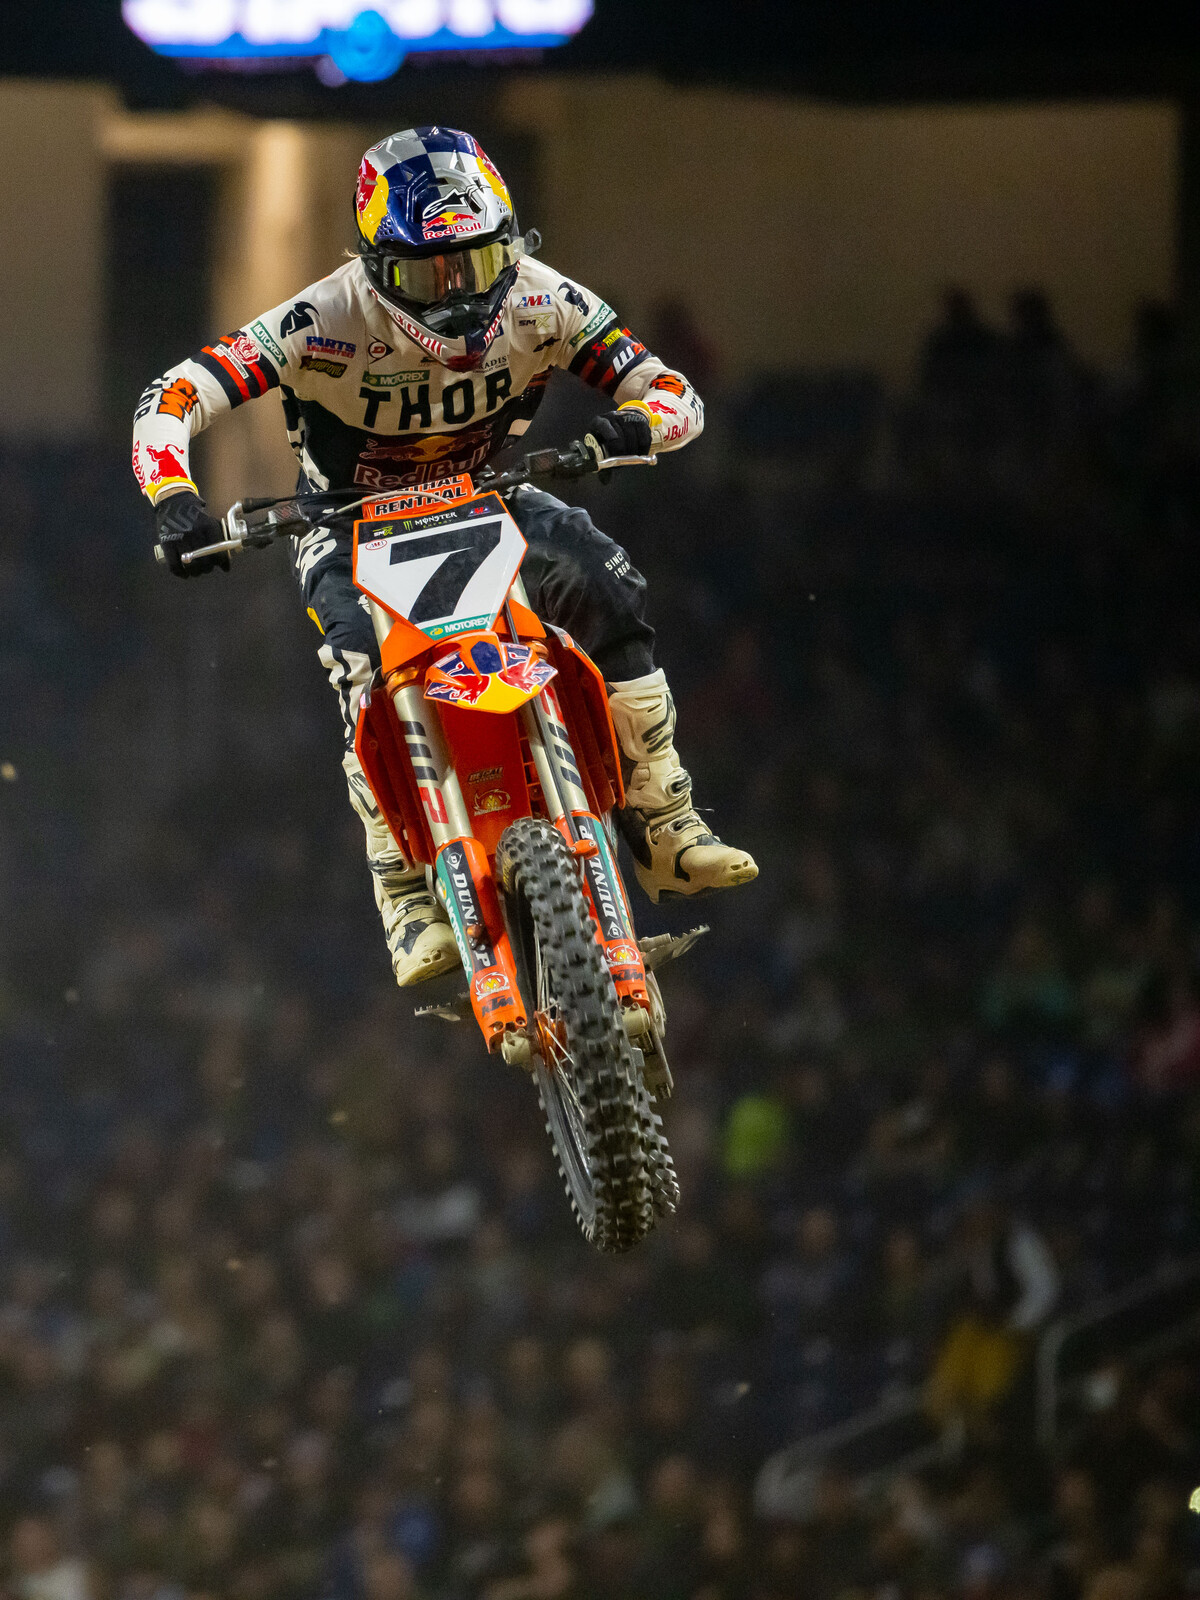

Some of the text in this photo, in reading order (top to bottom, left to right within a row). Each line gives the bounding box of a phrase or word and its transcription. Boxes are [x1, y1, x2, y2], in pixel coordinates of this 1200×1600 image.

[423, 223, 482, 240] Red Bull
[517, 294, 552, 309] AMA
[518, 313, 554, 329] SMX
[306, 336, 356, 353] PARTS
[379, 371, 425, 386] MOTOREX
[359, 367, 512, 431] THOR
[670, 416, 689, 441] Bull
[353, 441, 491, 490] Red Bull
[375, 486, 468, 517] RENTHAL
[414, 511, 458, 527] MONSTER
[389, 521, 503, 626] 7
[444, 615, 490, 634] MOTOREX
[579, 824, 618, 920] DUNLP
[453, 872, 492, 968] DUNP
